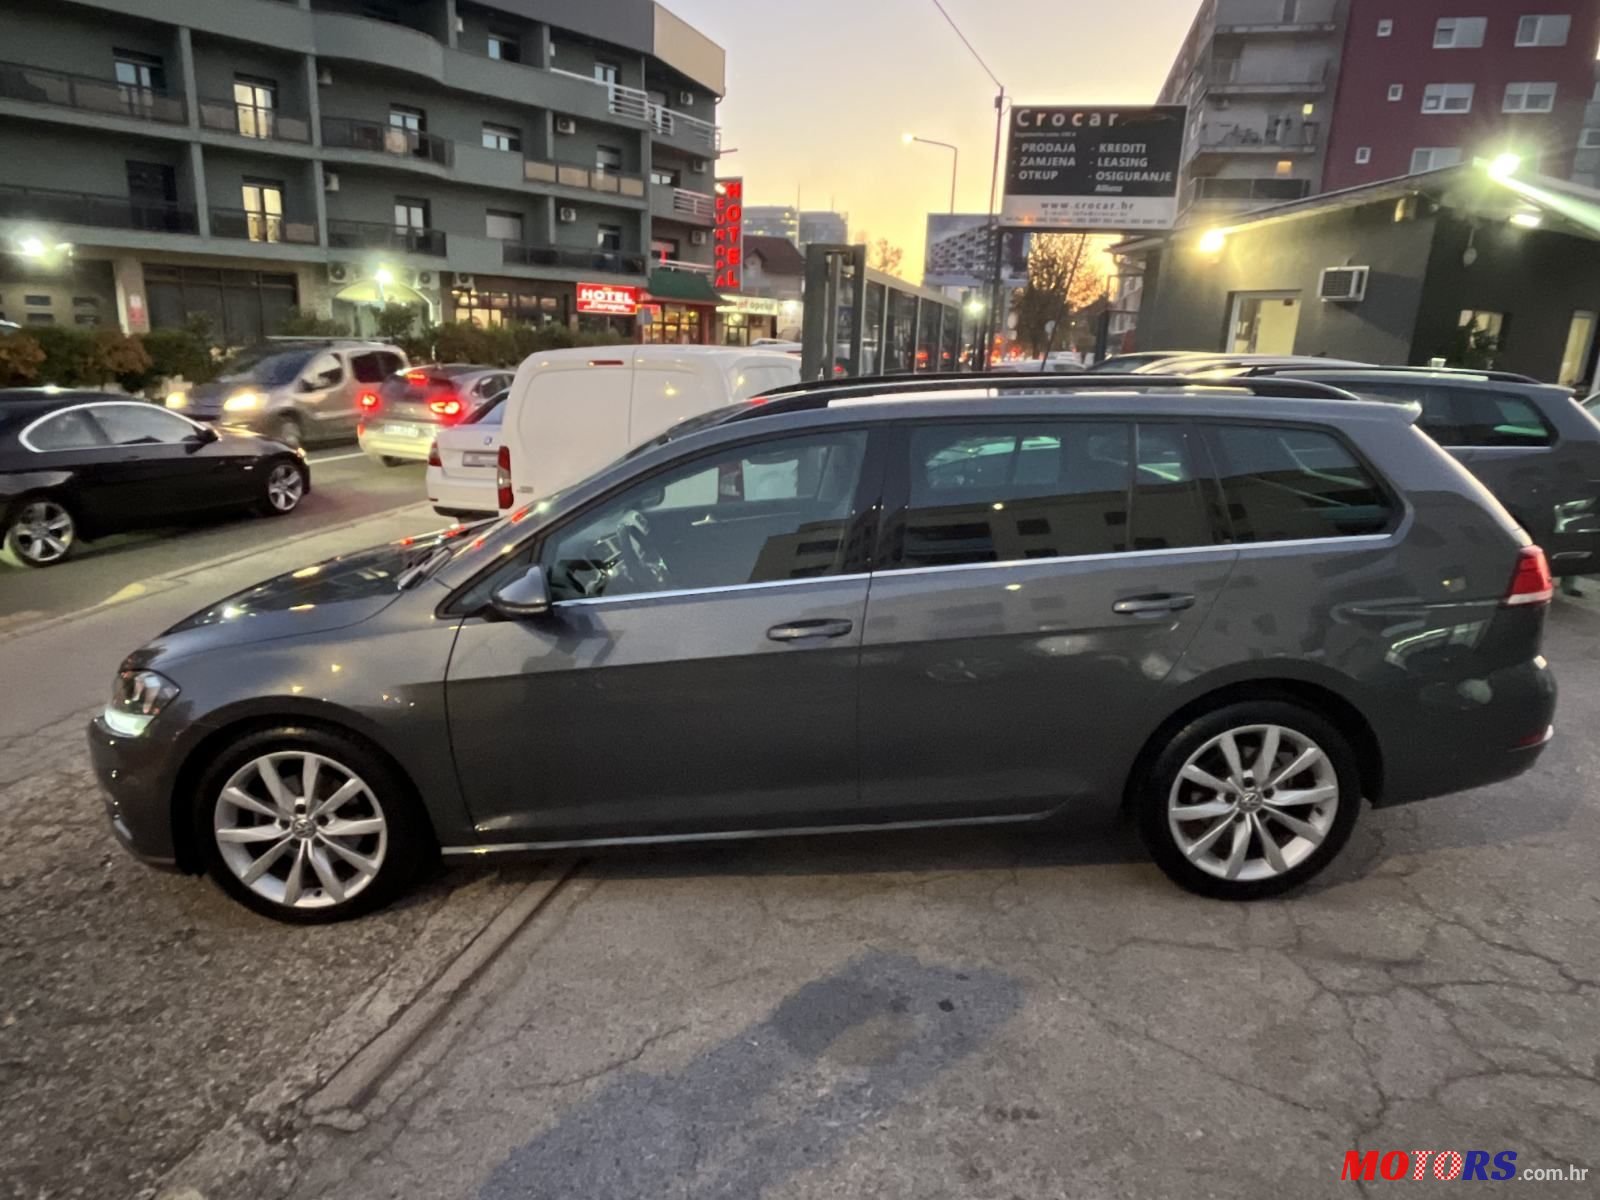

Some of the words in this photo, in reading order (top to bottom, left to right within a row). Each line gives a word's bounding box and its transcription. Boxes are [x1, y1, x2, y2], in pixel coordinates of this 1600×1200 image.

[1016, 109, 1119, 127] Crocar
[1021, 143, 1076, 153] PRODAJA
[1099, 143, 1147, 153] KREDITI
[1019, 157, 1076, 167] ZAMJENA
[1097, 157, 1149, 168] LEASING
[1018, 170, 1059, 180] OTKUP
[1095, 171, 1173, 182] OSIGURANJE
[1040, 201, 1134, 210] www.crocar.hr
[726, 181, 742, 289] HOTEL
[715, 196, 726, 288] EUROPA
[581, 288, 635, 305] HOTEL
